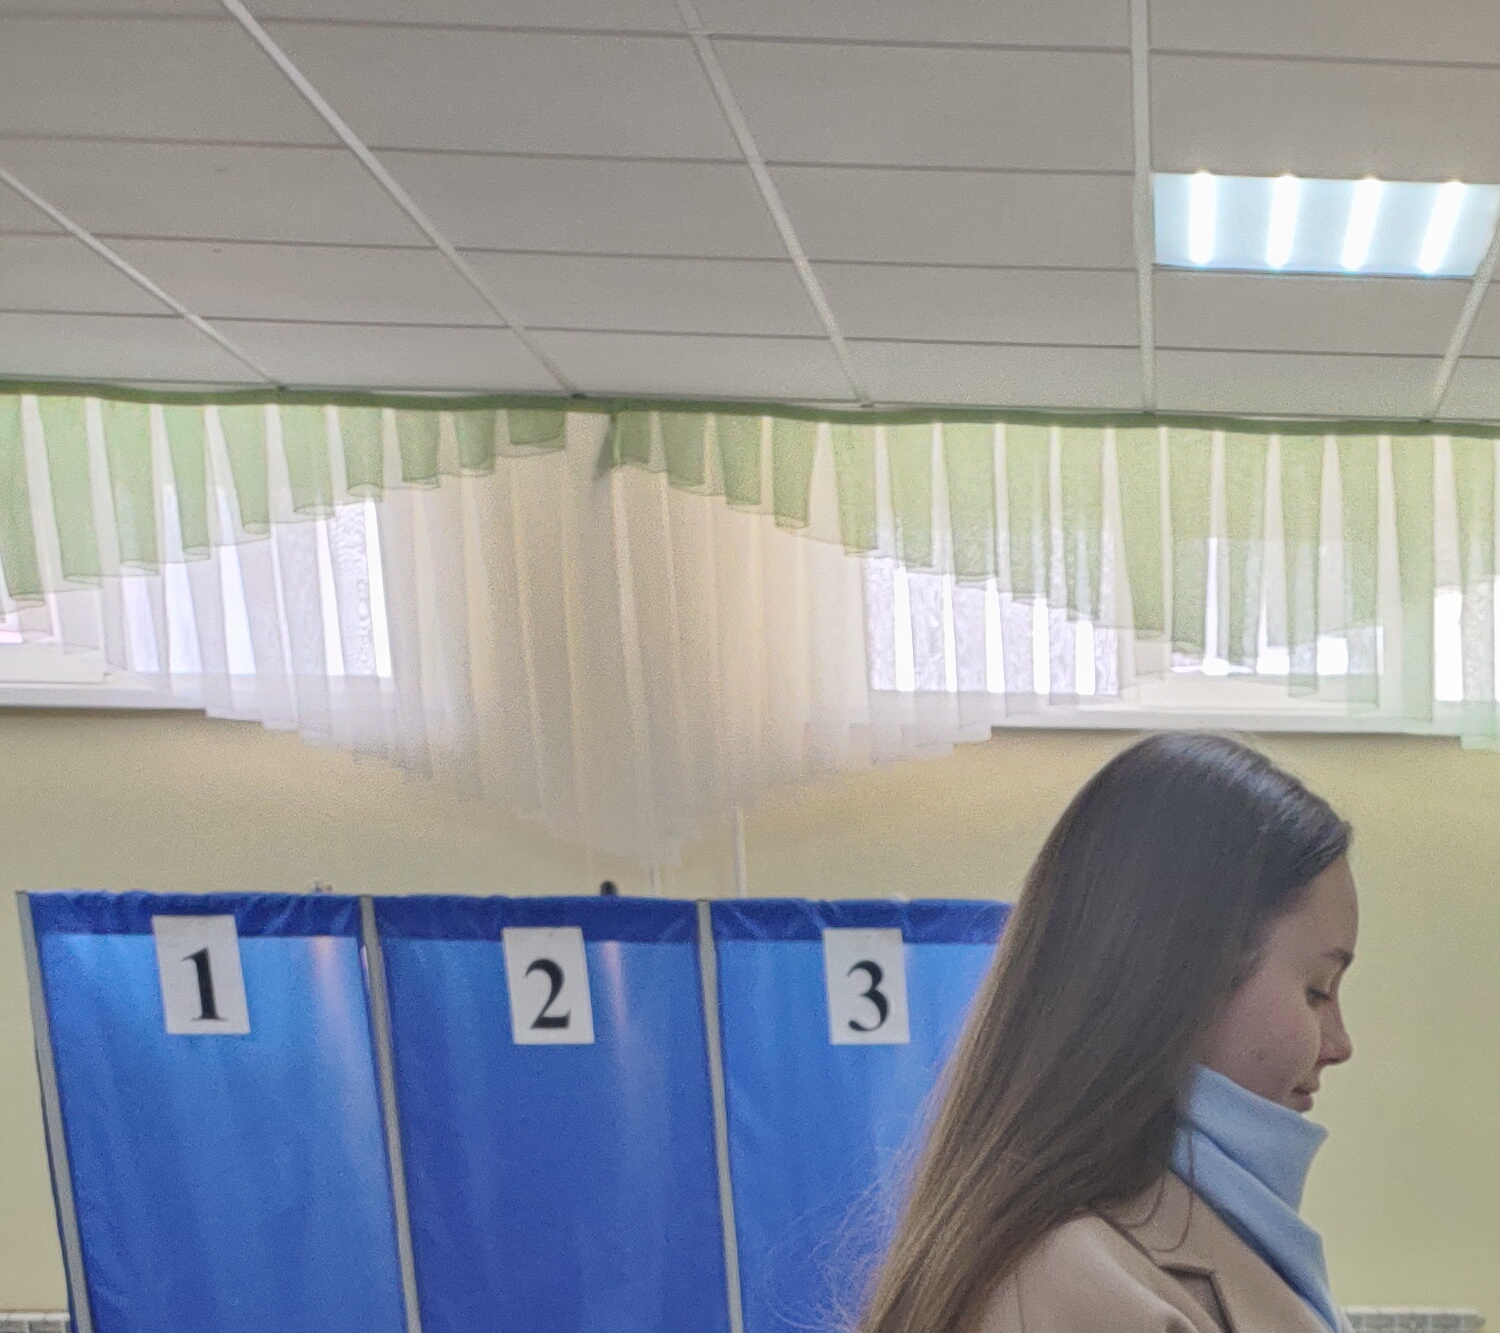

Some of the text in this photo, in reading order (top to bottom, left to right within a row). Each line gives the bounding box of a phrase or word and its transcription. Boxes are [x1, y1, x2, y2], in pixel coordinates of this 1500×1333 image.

[181, 947, 229, 1023] 1
[524, 958, 572, 1030] 2
[847, 960, 890, 1032] 3
